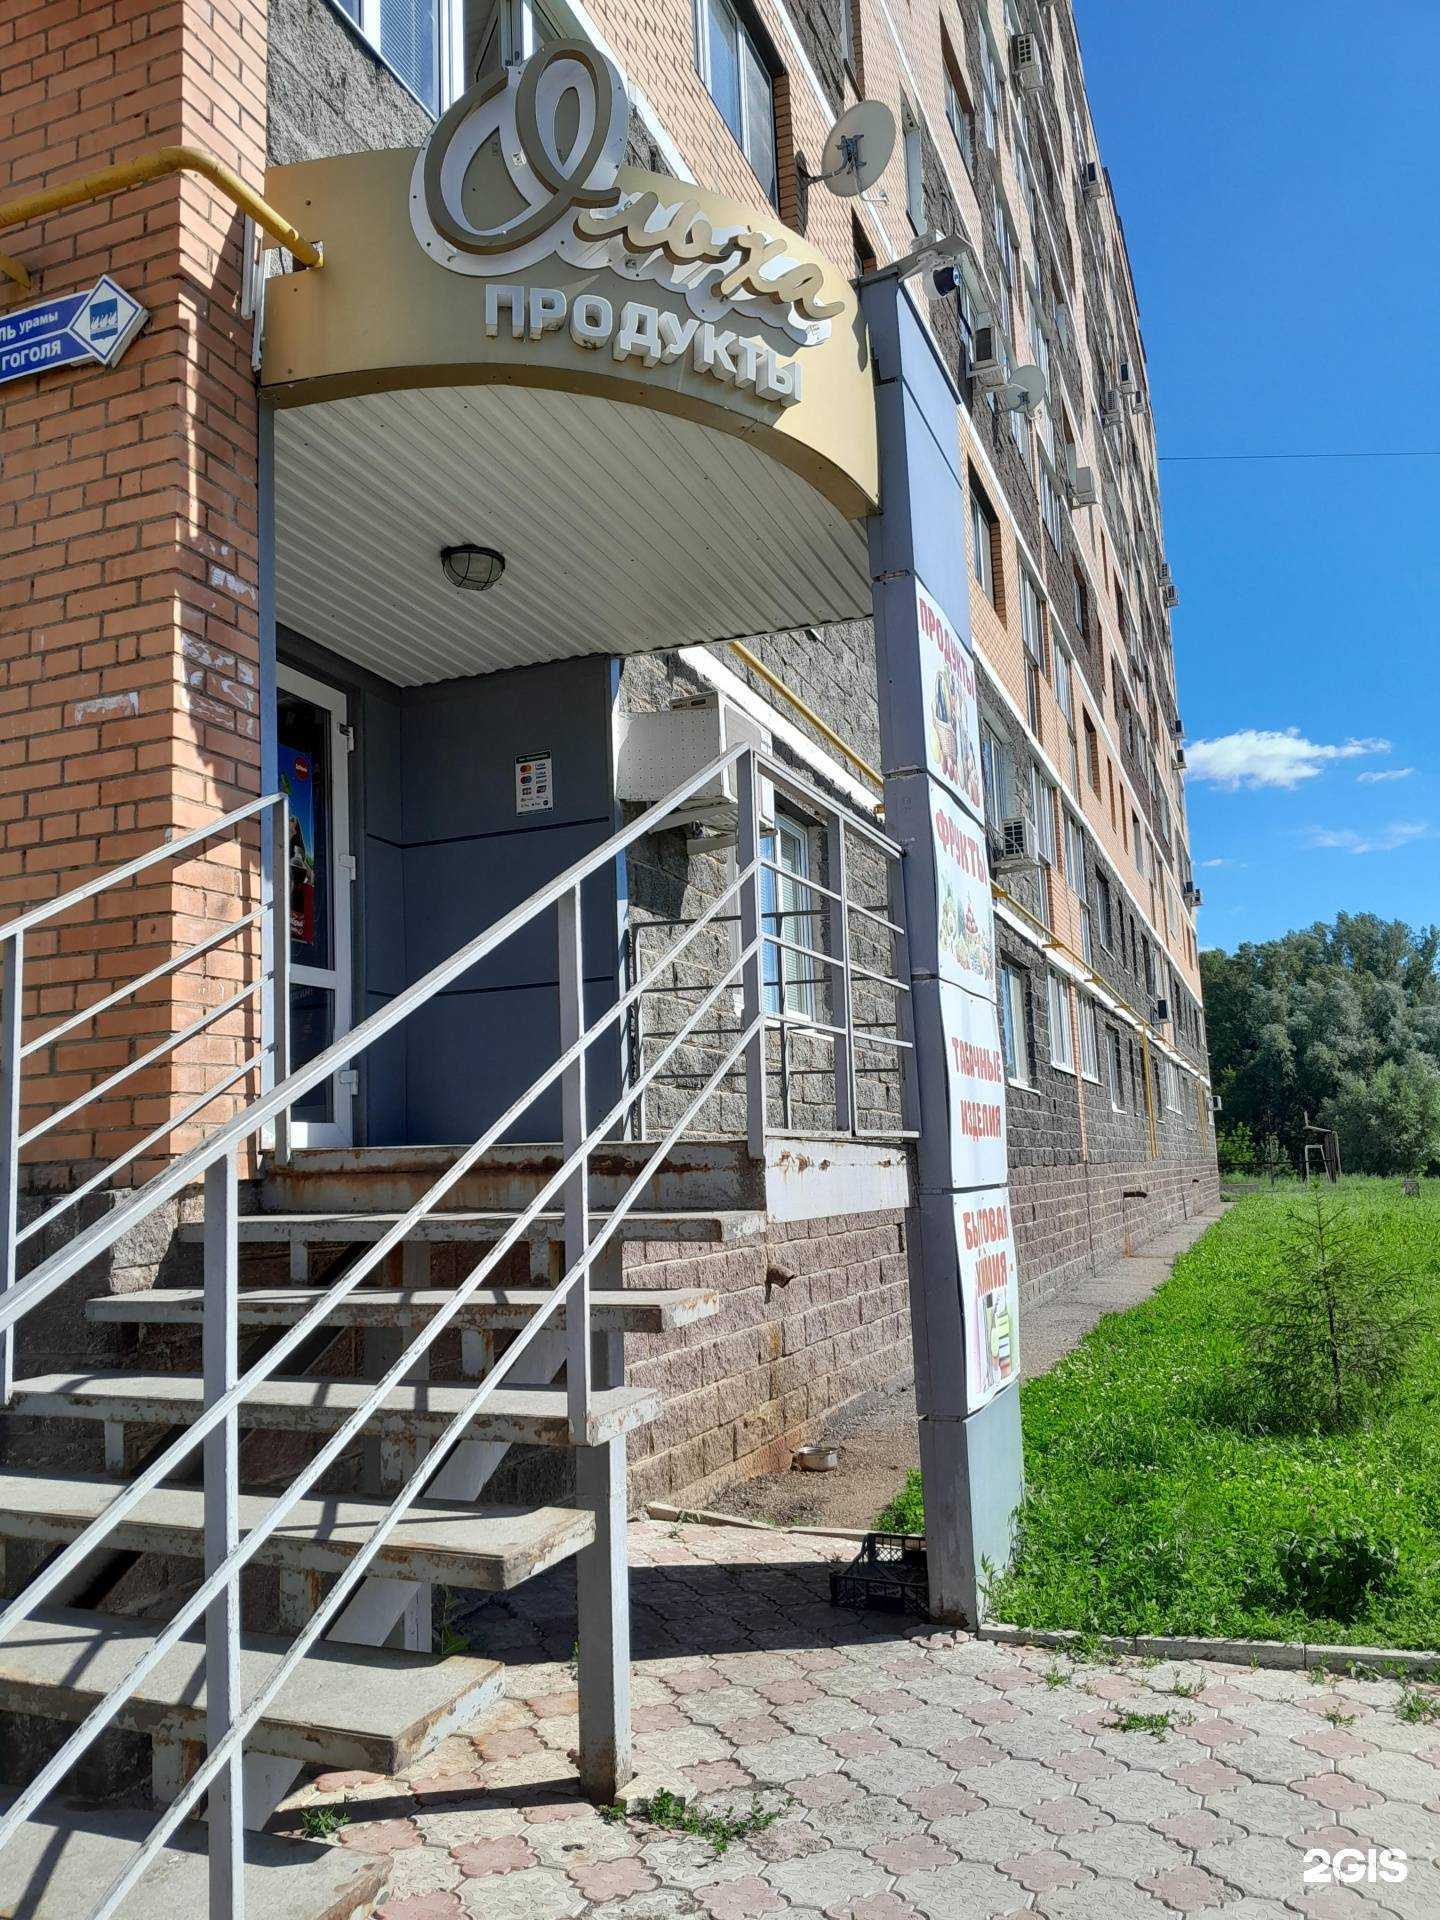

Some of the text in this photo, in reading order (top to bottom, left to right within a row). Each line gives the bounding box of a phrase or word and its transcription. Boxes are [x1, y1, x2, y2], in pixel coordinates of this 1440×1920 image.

[19, 311, 59, 336] урамы
[485, 284, 802, 405] ПРОДУКТЫ
[2, 339, 62, 371] ГОГОЛЯ
[919, 597, 975, 701] ПРОДУКТЫ
[936, 808, 988, 886] ФРУКТЫ
[951, 1036, 1002, 1083] ТАБАЧНЫЕ
[960, 1099, 1002, 1142] ИЗДЕЛИЯ
[963, 1204, 1009, 1250] БЫТОВАЯ
[975, 1250, 1008, 1298] ХИМИЯ
